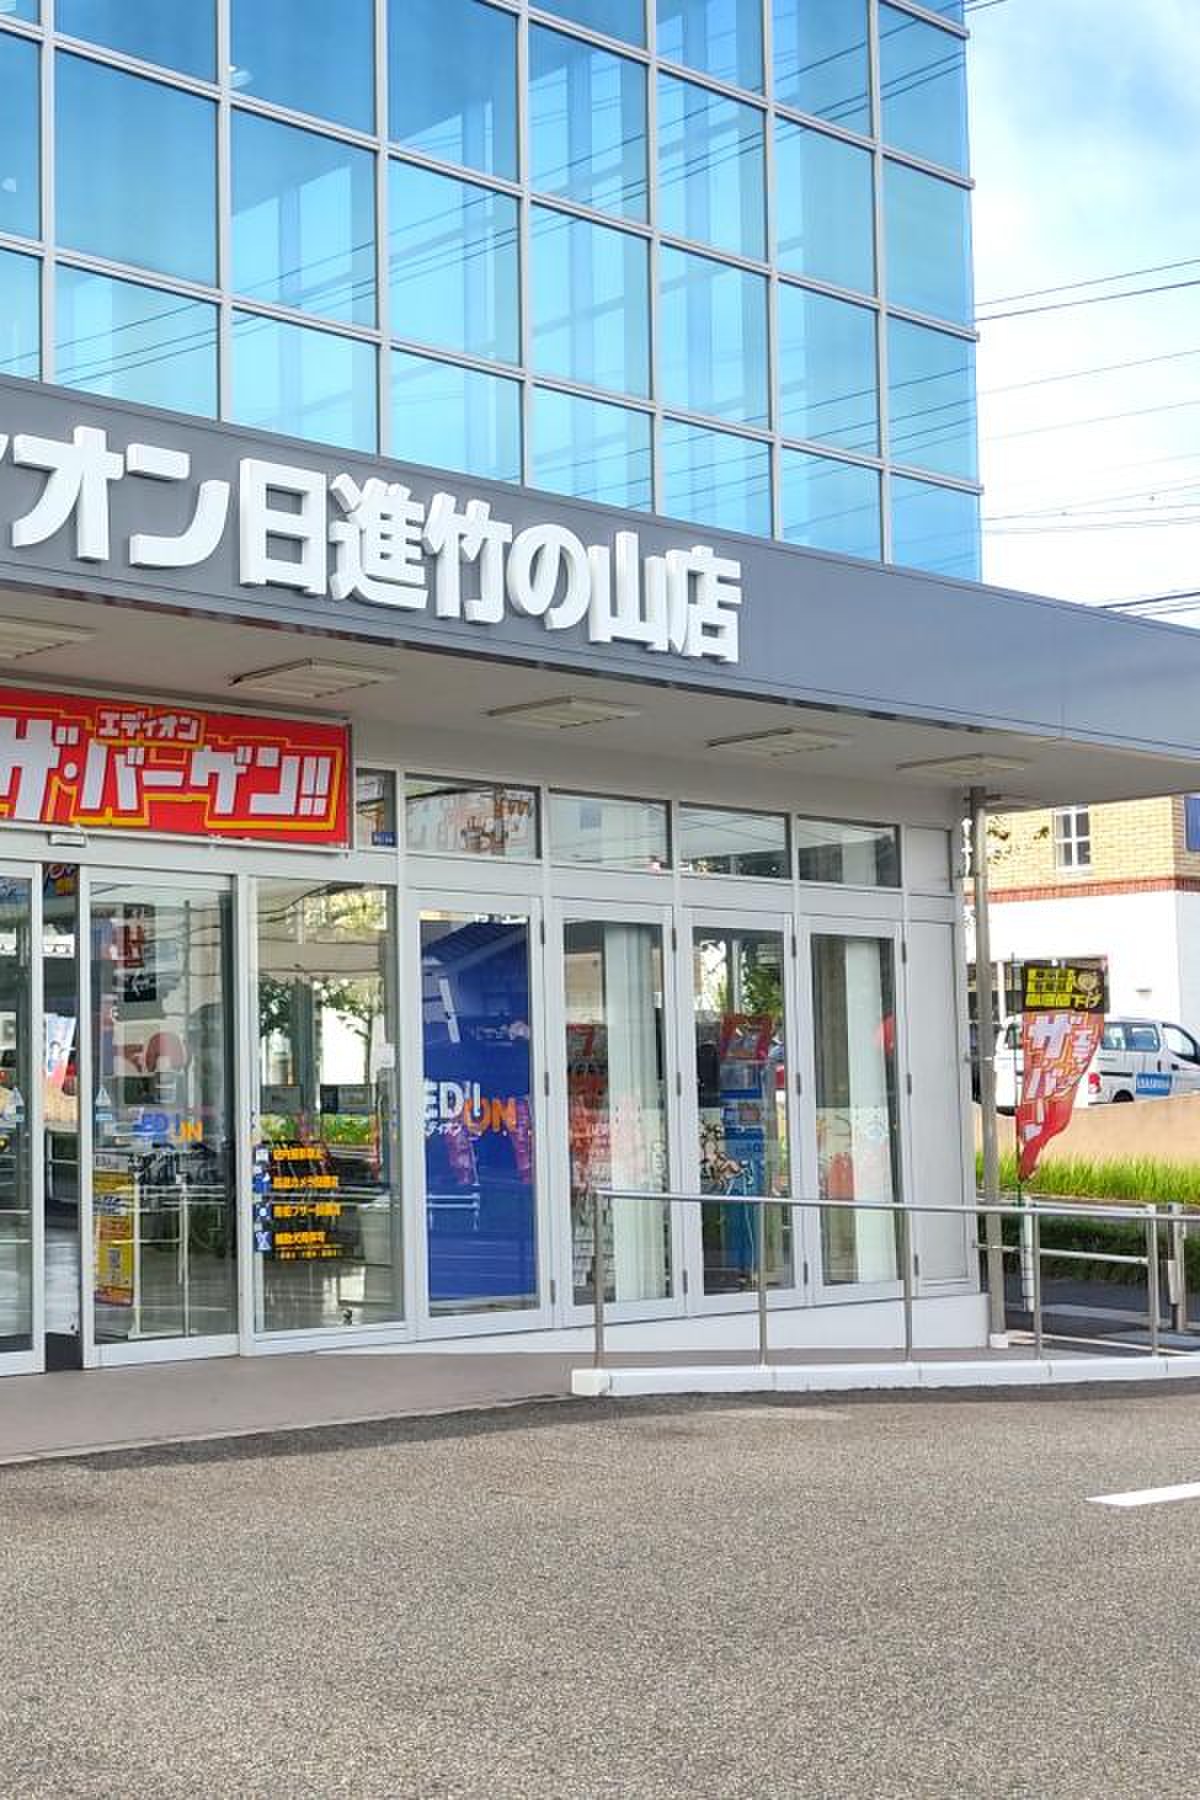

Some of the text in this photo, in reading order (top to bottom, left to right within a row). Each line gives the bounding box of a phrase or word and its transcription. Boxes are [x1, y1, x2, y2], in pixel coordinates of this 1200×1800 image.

[99, 709, 200, 743] エディオン
